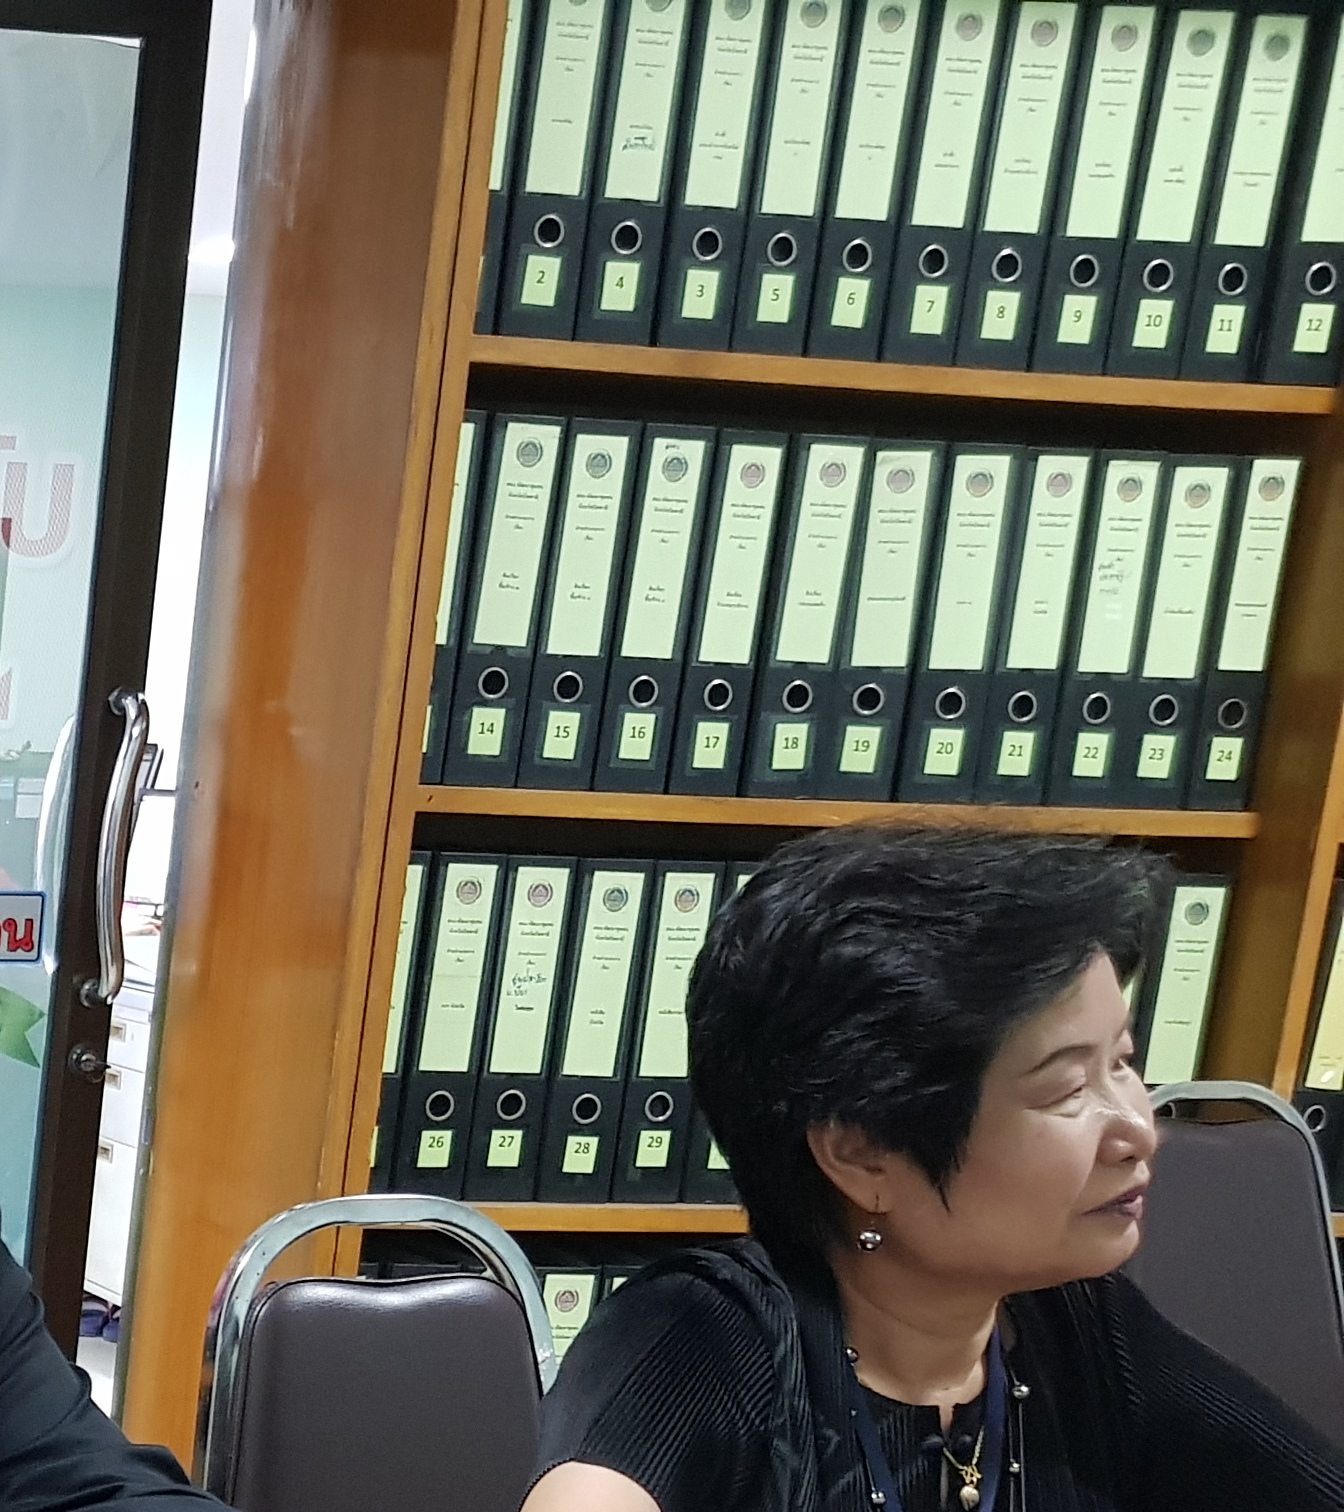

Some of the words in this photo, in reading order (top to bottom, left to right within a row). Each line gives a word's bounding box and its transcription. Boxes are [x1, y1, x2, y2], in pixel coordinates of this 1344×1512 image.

[536, 270, 546, 284] 2
[615, 276, 624, 289] 4
[696, 284, 705, 298] 3
[771, 288, 780, 302] 5
[846, 292, 856, 306] 6
[926, 299, 935, 313] 7
[996, 305, 1006, 319] 8
[1073, 309, 1082, 323] 9
[1145, 314, 1163, 328] 10
[1218, 318, 1233, 332] 11
[1306, 318, 1323, 332] 12
[478, 722, 495, 735] 14
[554, 725, 570, 739] 15
[630, 726, 646, 739] 16
[704, 736, 720, 749] 17
[783, 736, 799, 750] 18
[853, 739, 871, 753] 19
[935, 741, 954, 755] 20
[1007, 744, 1023, 757] 21
[1082, 746, 1099, 759] 22
[1148, 748, 1165, 761] 23
[1217, 750, 1232, 762] 24
[428, 1136, 444, 1148] 26
[498, 1135, 515, 1148] 27
[574, 1142, 590, 1154] 28
[647, 1136, 663, 1148] 29
